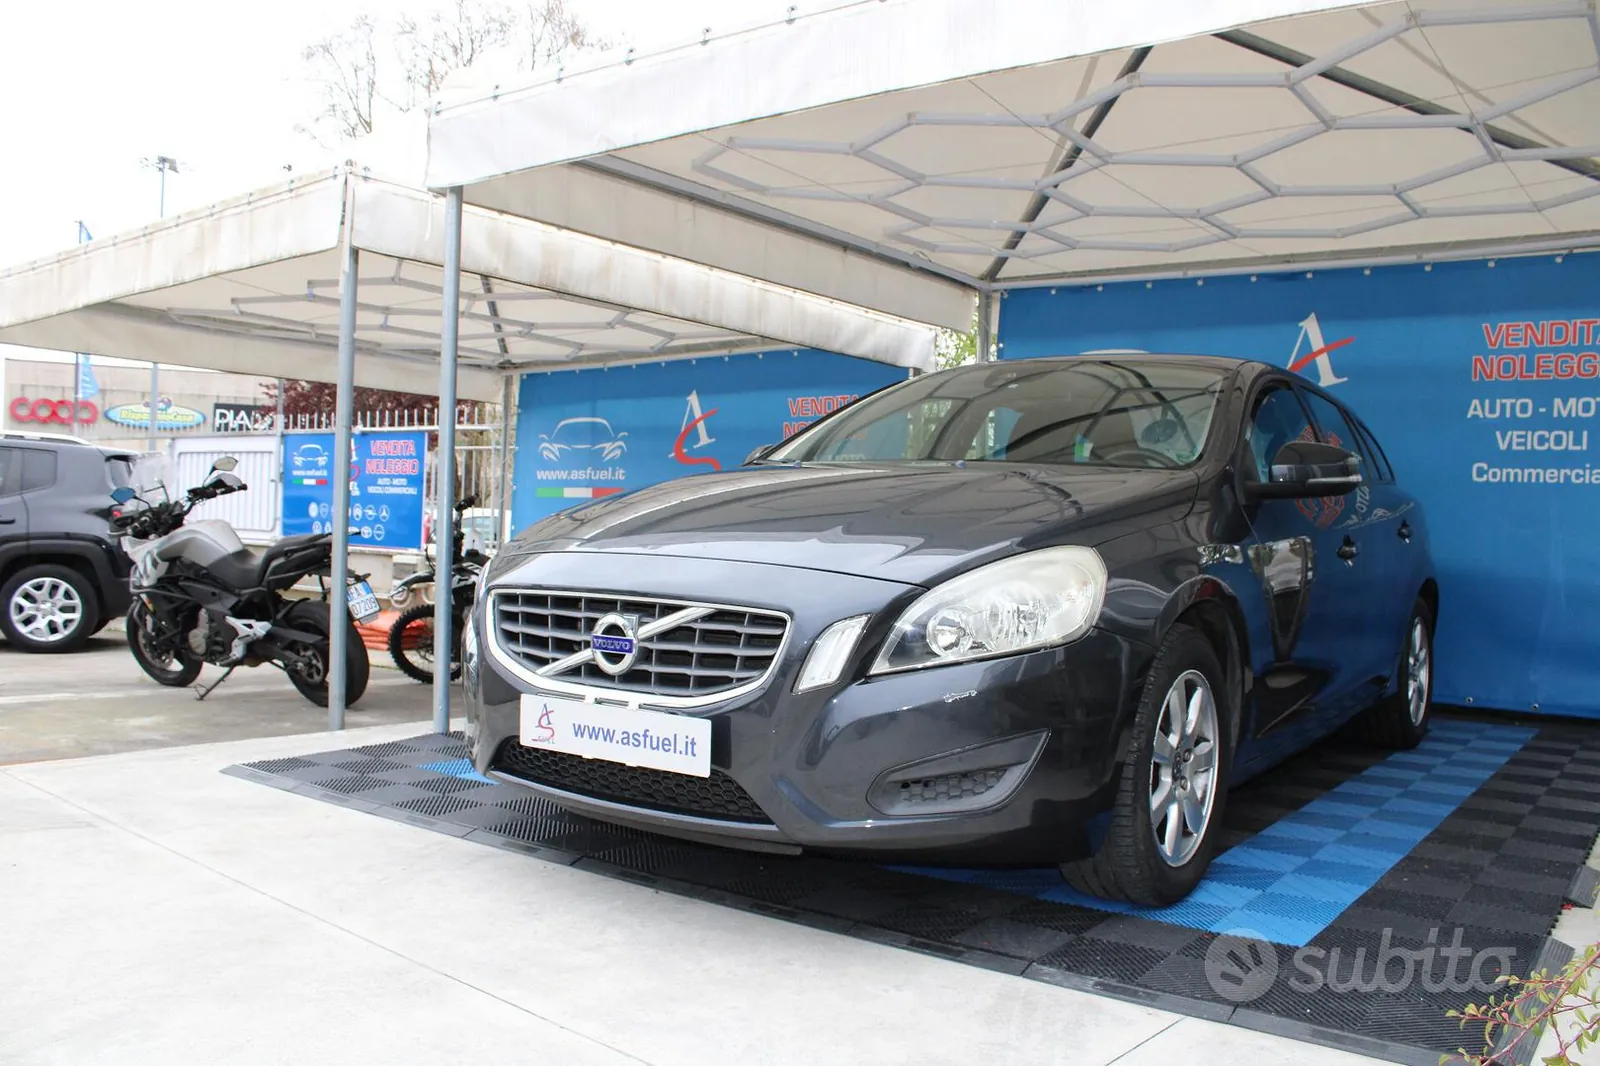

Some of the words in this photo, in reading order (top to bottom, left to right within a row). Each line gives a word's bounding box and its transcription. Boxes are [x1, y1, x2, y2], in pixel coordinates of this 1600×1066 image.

[1482, 319, 1600, 348] VENDIT
[1472, 352, 1600, 381] NOLEGG
[788, 394, 860, 417] VENDIT
[1467, 398, 1533, 418] AUTO
[370, 440, 416, 456] VENDITA
[1496, 430, 1588, 451] VEICOLI
[365, 458, 419, 475] NOLEGGIO
[536, 467, 626, 481] www.asfuel.it
[593, 638, 631, 650] VOLVO
[572, 721, 697, 757] www.asfuel.it
